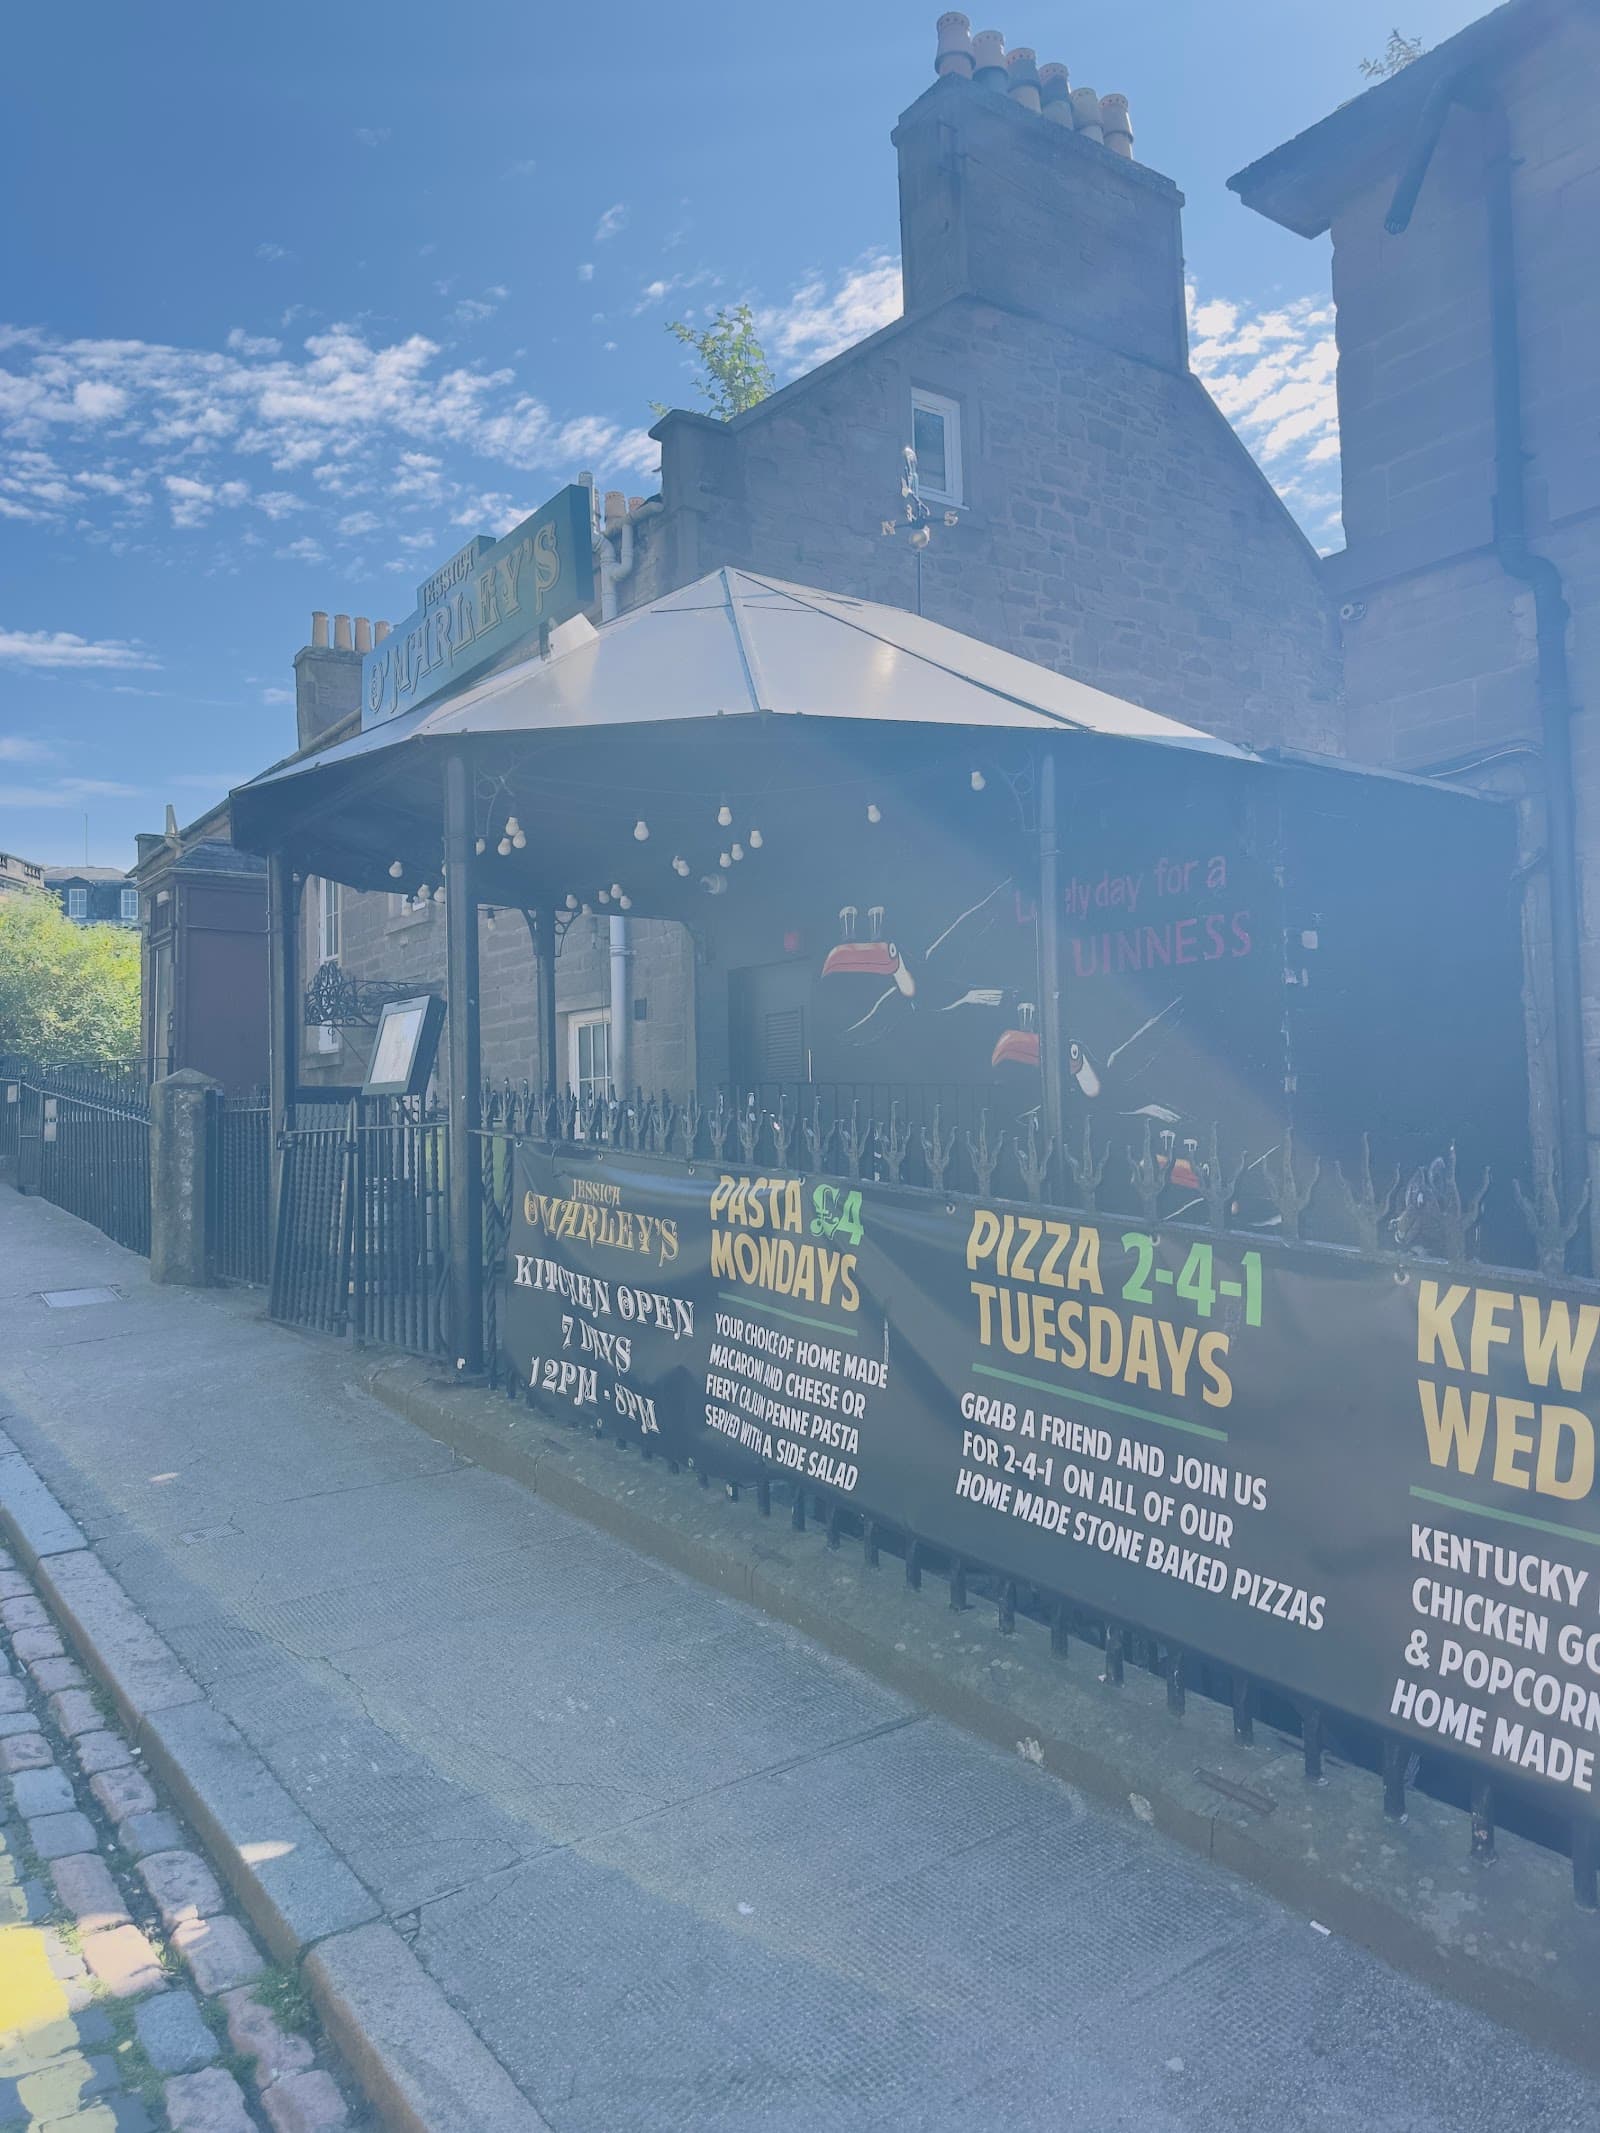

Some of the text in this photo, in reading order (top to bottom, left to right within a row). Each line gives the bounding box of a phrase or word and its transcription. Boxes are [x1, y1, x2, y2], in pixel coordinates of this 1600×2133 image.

[368, 519, 561, 715] O'MARLEY'S
[423, 546, 475, 618] JESSICA
[1095, 868, 1143, 912] day
[1153, 856, 1199, 897] for
[1206, 855, 1229, 889] a
[1071, 911, 1254, 977] UINNESS
[571, 1178, 622, 1207] JESSICA
[710, 1175, 864, 1247] PASTA £4
[711, 1229, 861, 1312] MONDAYS
[966, 1208, 1263, 1328] PIZZA 2-4-1
[561, 1313, 575, 1350] 7
[617, 1285, 695, 1341] OPEN
[715, 1313, 889, 1389] YOUR CHOICE OF HOME MADE
[971, 1282, 1233, 1408] TUESDAYS
[1417, 1279, 1600, 1393] KFW
[529, 1356, 599, 1406] 12PM
[615, 1382, 661, 1435] 8PM
[706, 1373, 859, 1455] FIERY CAJUN PENNE PASTA
[709, 1344, 866, 1419] MACARONI AND CHEESE OR
[705, 1405, 859, 1492] SERVED WITH A SIDE SALAD
[960, 1392, 1267, 1512] GRAB A FRIEND AND JOIN US
[1417, 1379, 1596, 1501] WED
[962, 1430, 1233, 1549] FOR 2-4-1 ON ALL OF OUR
[956, 1469, 1326, 1631] HOME MADE STONE BAKED PIZZAS
[1410, 1523, 1590, 1608] KENTUCKY
[1404, 1629, 1431, 1669] &
[1412, 1577, 1549, 1655] CHICKEN
[1390, 1678, 1595, 1793] HOME MADE
